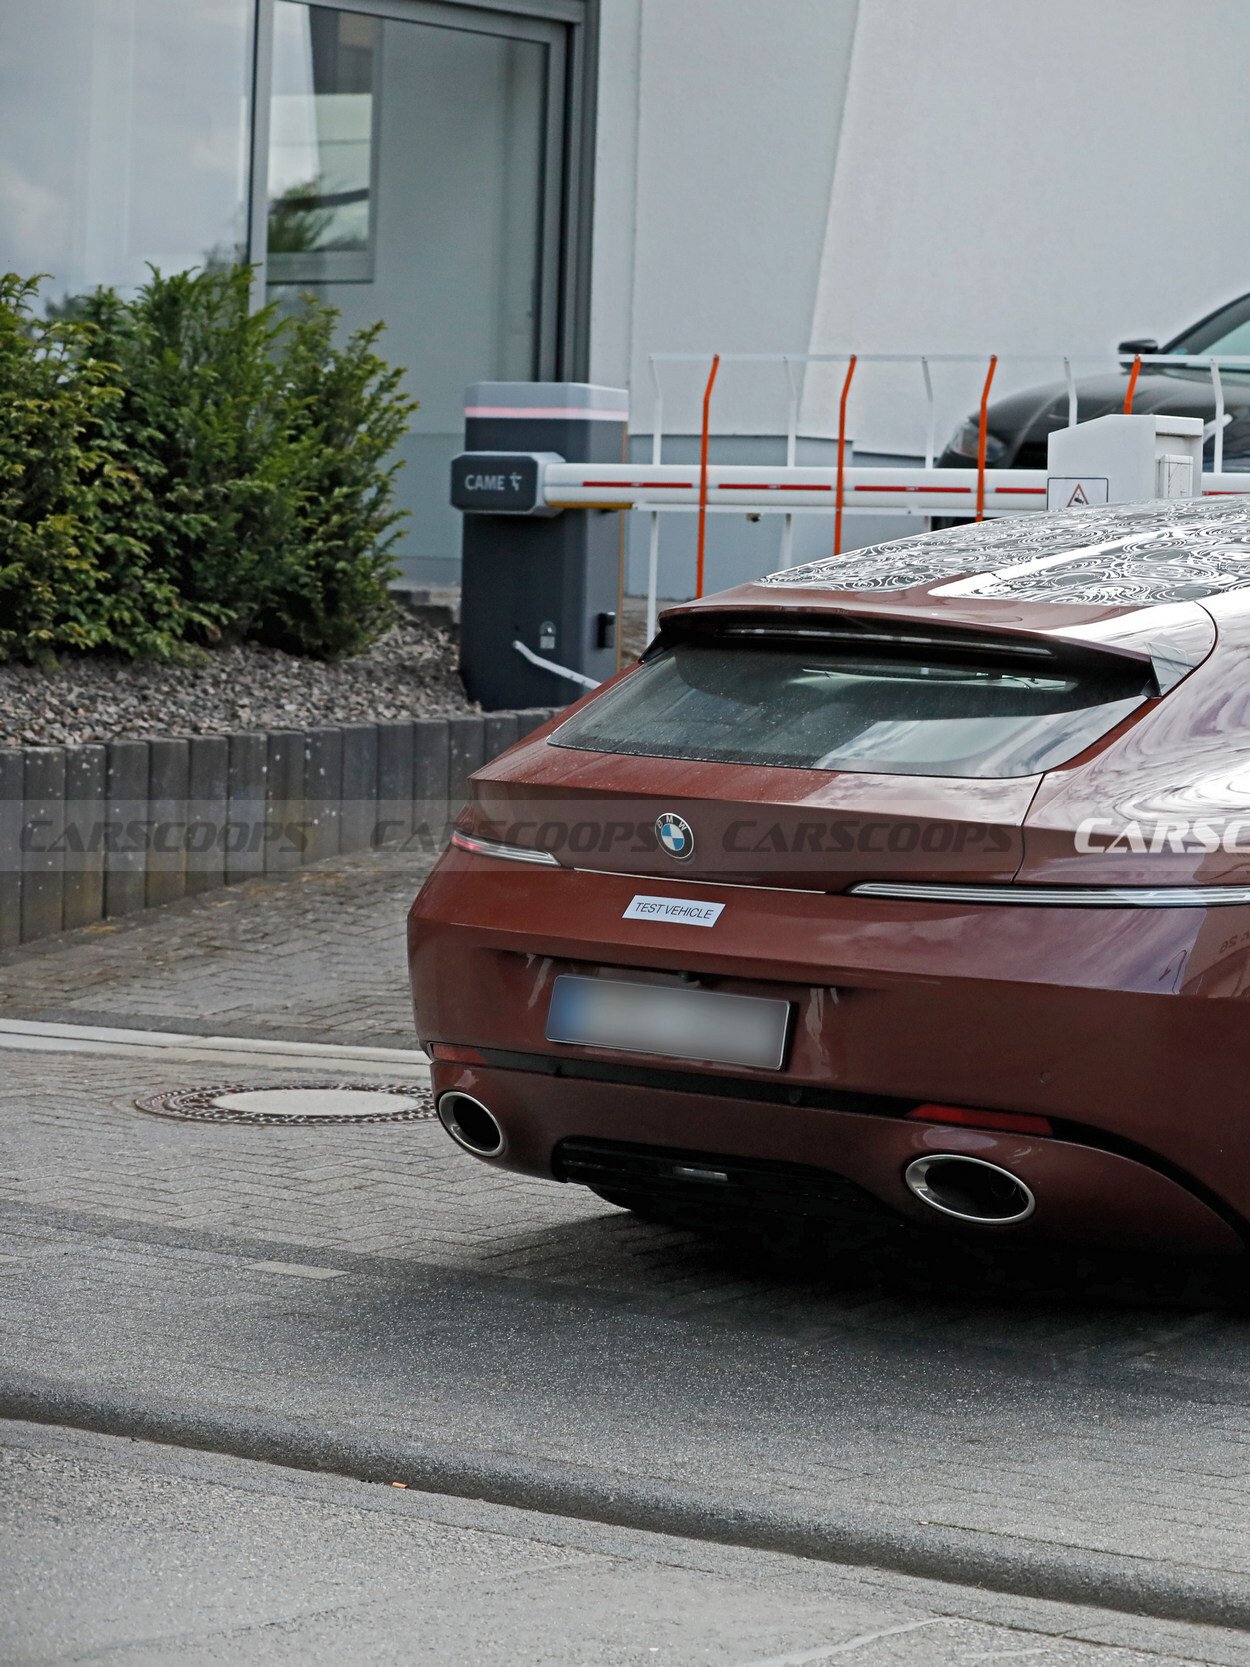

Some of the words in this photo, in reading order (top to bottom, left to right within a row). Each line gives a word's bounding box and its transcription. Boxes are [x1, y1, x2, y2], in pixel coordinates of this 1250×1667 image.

[464, 474, 505, 490] CAME
[656, 814, 687, 831] BMW
[635, 902, 665, 914] TEST
[665, 905, 714, 919] VEHICLE
